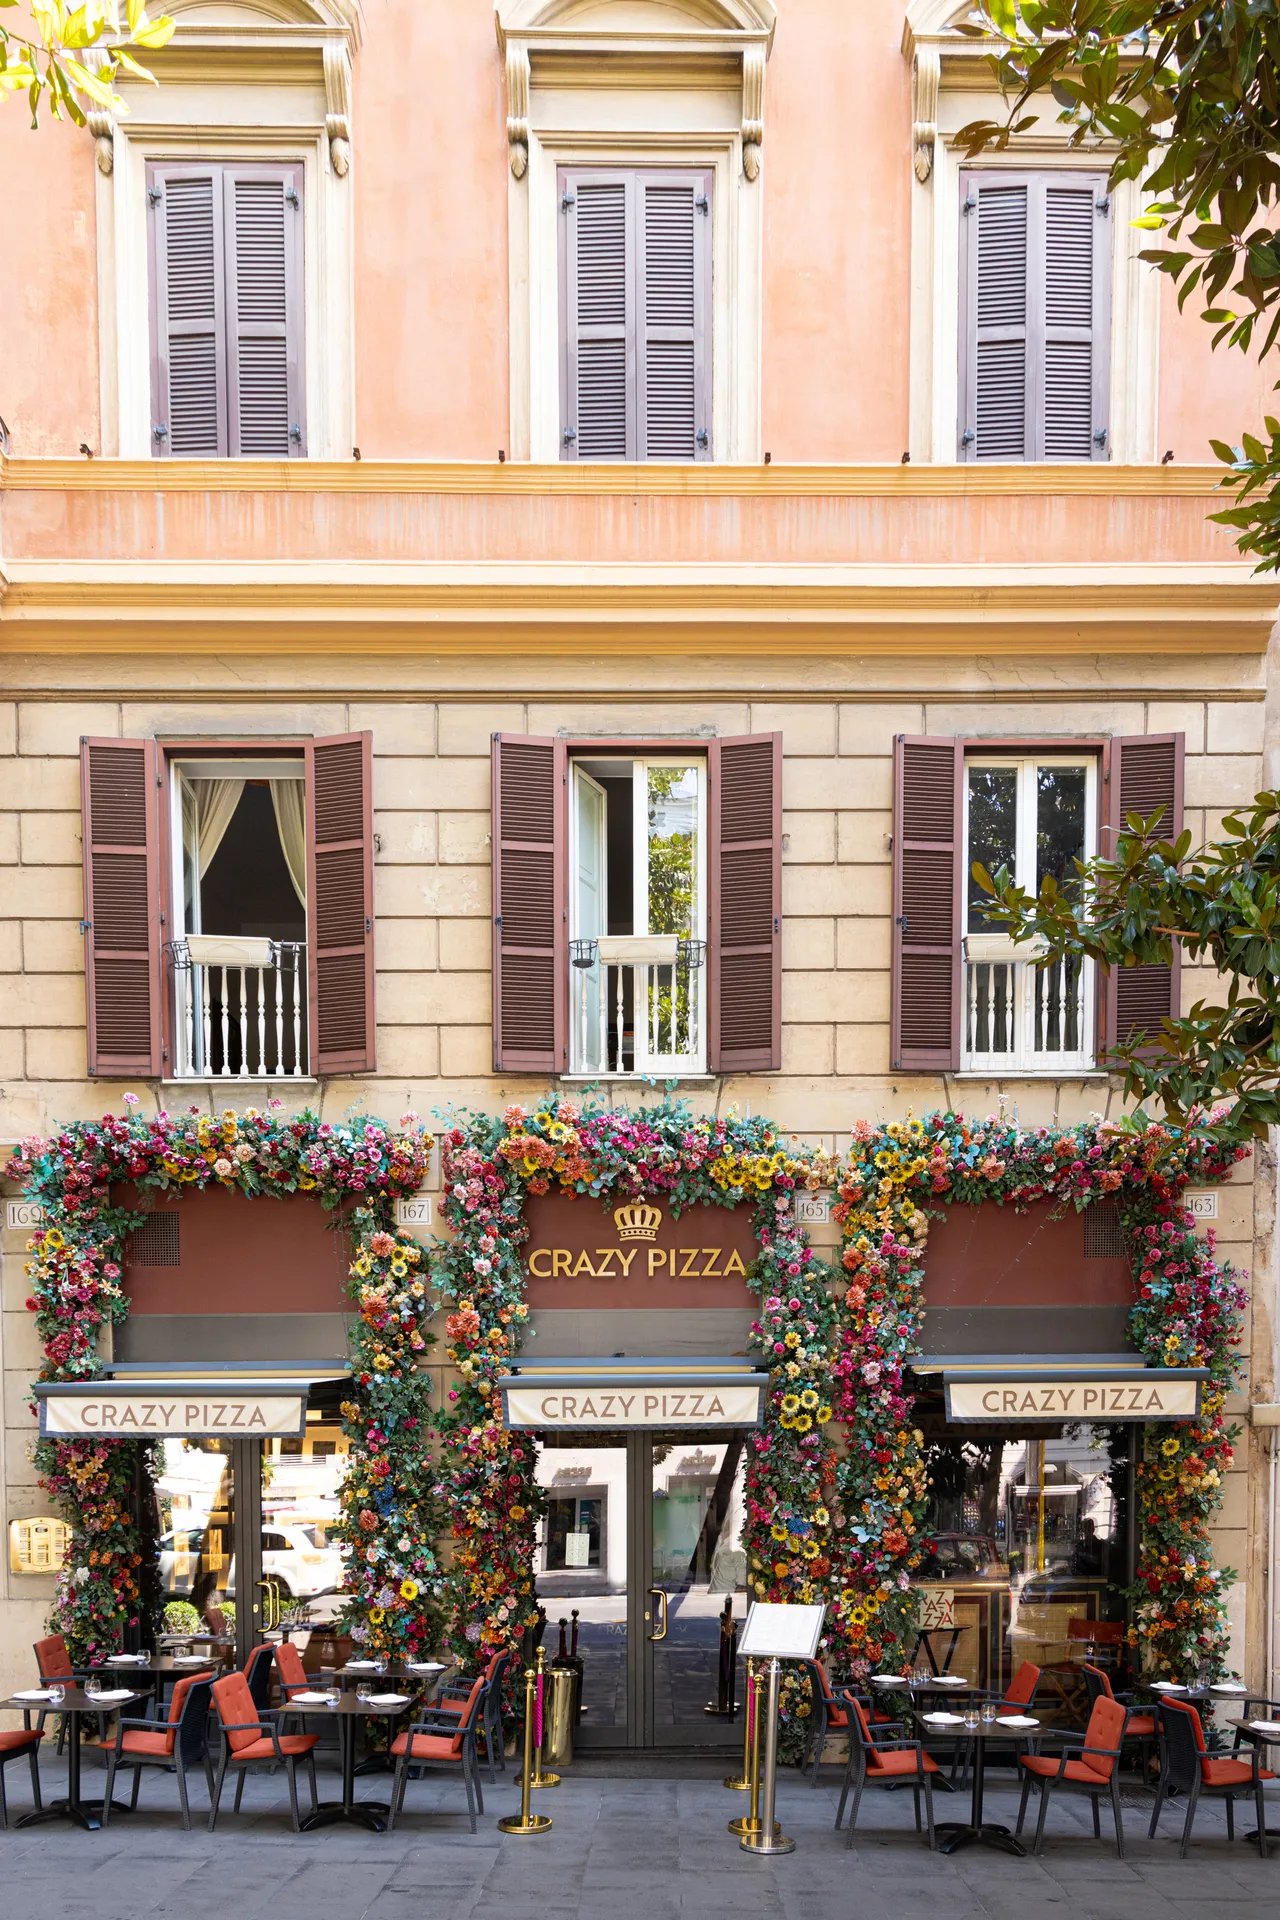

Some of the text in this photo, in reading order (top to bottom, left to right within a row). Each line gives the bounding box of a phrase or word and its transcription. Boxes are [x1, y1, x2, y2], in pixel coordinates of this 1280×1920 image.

[12, 1206, 42, 1224] 169
[402, 1204, 425, 1219] 167
[801, 1203, 823, 1217] 165
[1190, 1198, 1212, 1212] 163
[528, 1248, 746, 1277] CRAZY PIZZA
[540, 1394, 726, 1418] CRAZY PIZZA
[982, 1388, 1164, 1412] CRAZY PIZZA
[80, 1404, 267, 1427] CRAZY PIZZA
